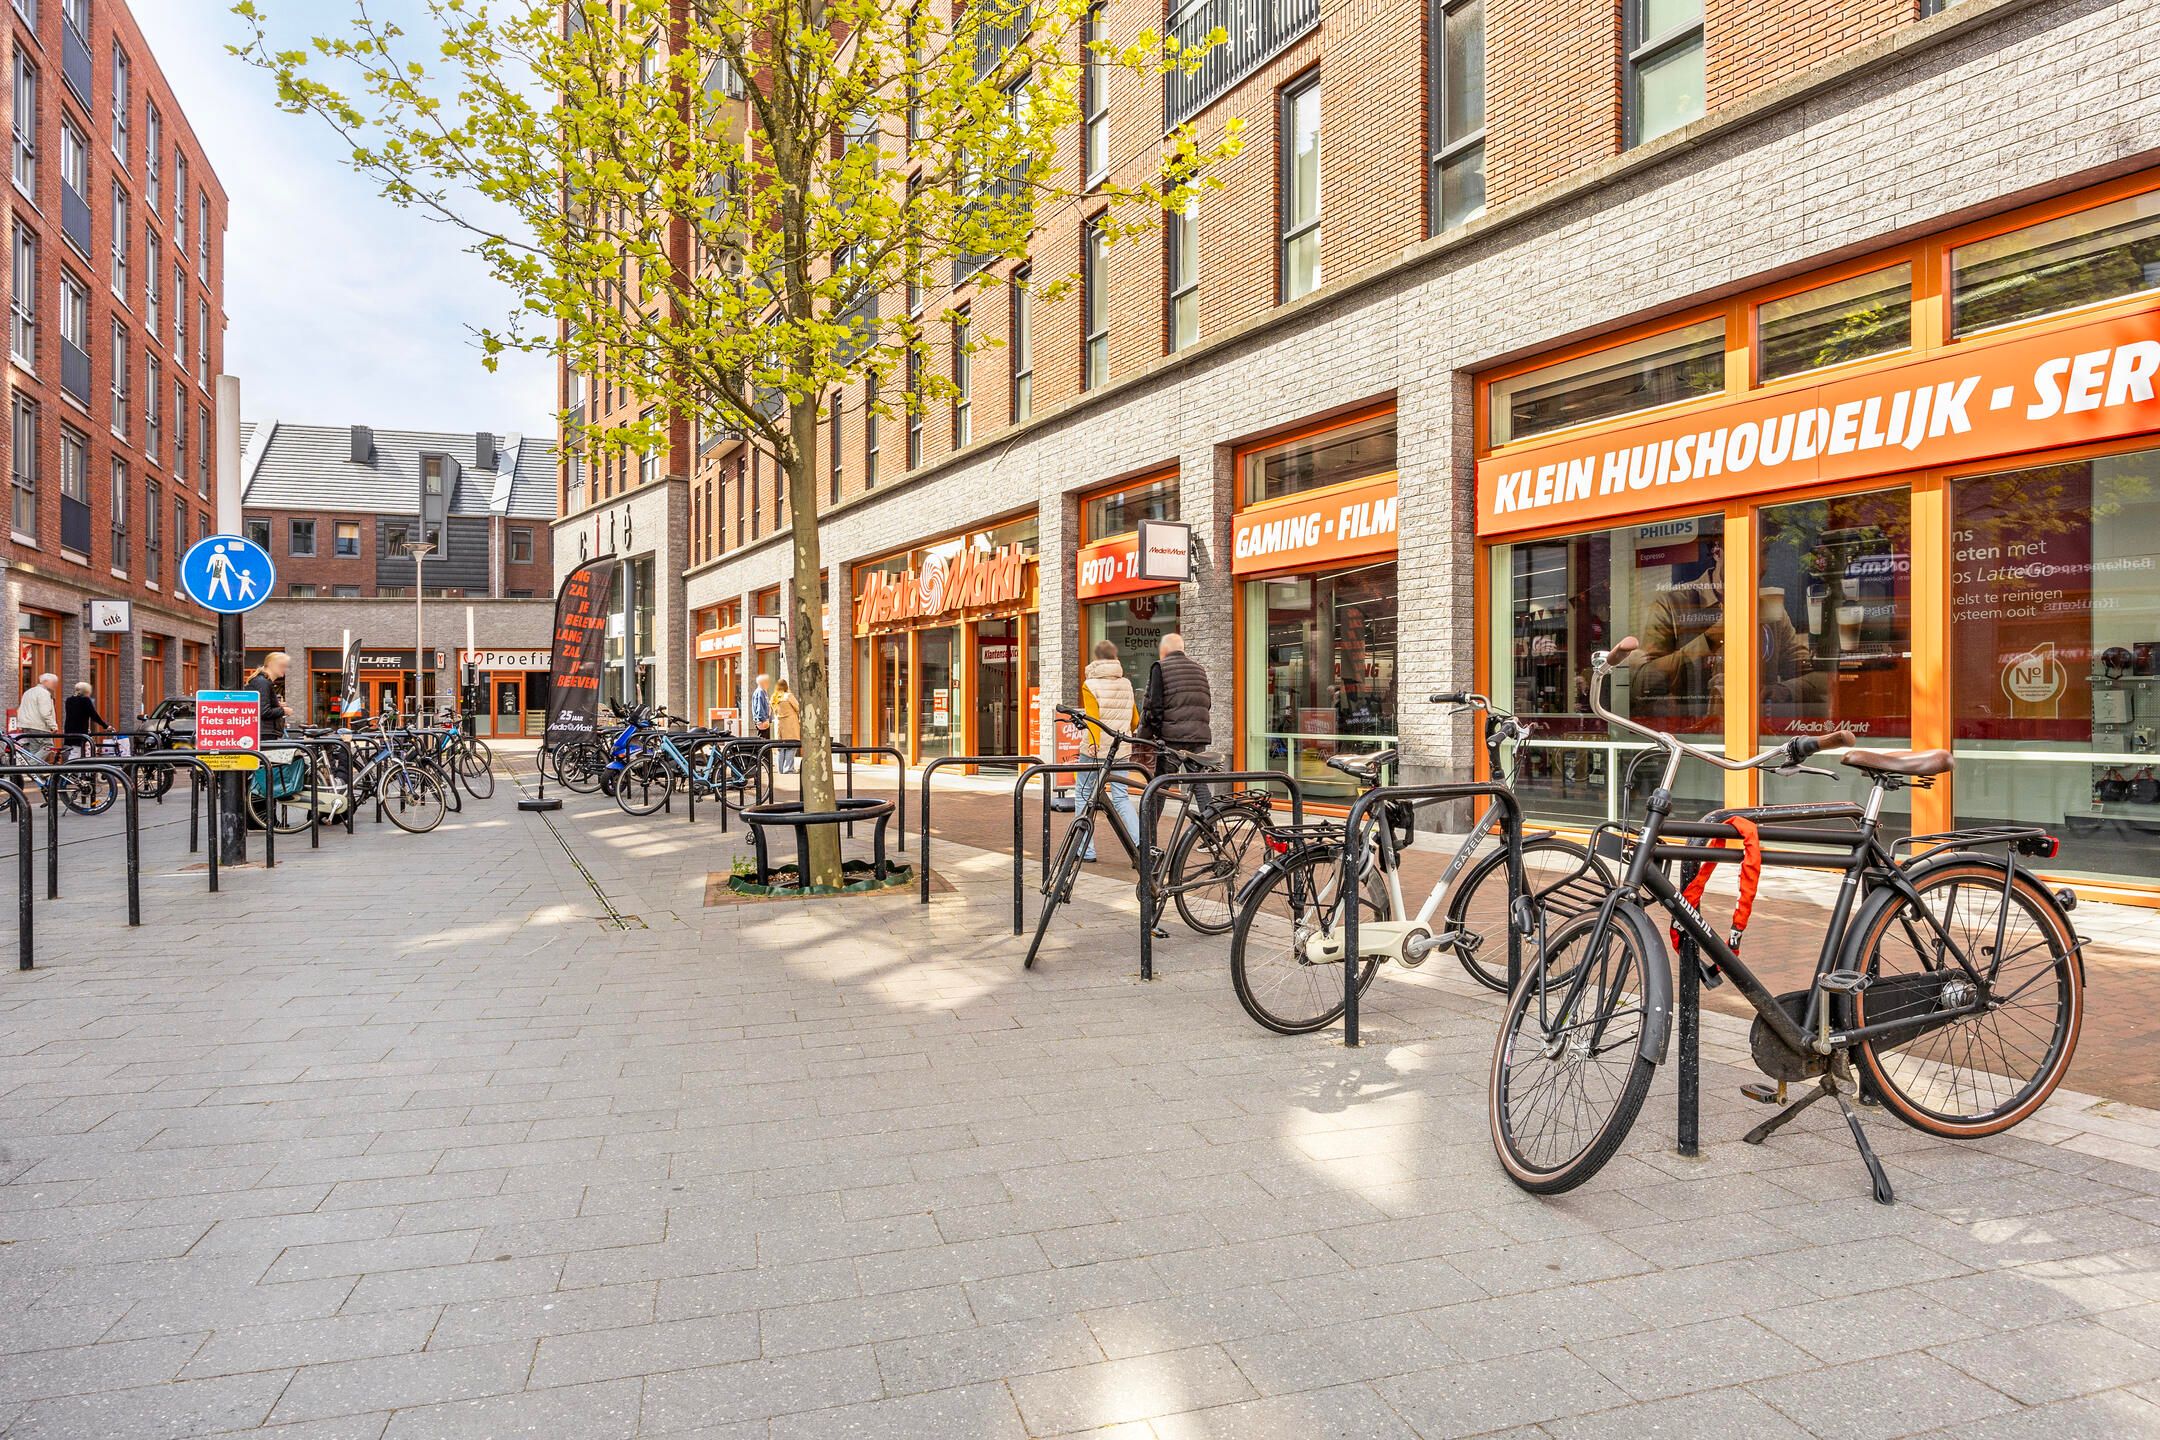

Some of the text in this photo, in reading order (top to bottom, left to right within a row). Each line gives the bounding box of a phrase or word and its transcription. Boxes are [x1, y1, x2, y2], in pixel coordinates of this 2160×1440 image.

[1493, 340, 2160, 515] KLEIN HUISHOUDELIJK SER
[1235, 496, 1398, 559] GAMING FILM
[1640, 521, 1693, 539] PHILIPS
[2007, 540, 2048, 557] met
[1640, 552, 1665, 561] Espresso
[1081, 556, 1115, 587] FOTO
[1977, 562, 2055, 582] LatteGo
[568, 583, 589, 598] ZAL
[1985, 592, 1999, 603] te
[2002, 588, 2063, 604] reinigen
[578, 600, 591, 614] JE
[2006, 604, 2037, 618] ooit
[555, 627, 583, 643] LANG
[1127, 625, 1161, 637] Douwe
[1124, 637, 1158, 650] Egbert
[562, 644, 581, 658] ZAL
[359, 656, 402, 664] CUBE
[201, 705, 239, 714] Parkeer
[560, 709, 574, 721] 25
[200, 716, 224, 725] fiets
[226, 716, 251, 727] altijd
[1785, 720, 1871, 733] Media Markt
[200, 727, 234, 736] tussen
[200, 738, 242, 747] de rekke
[1454, 822, 1490, 870] GAZELLE
